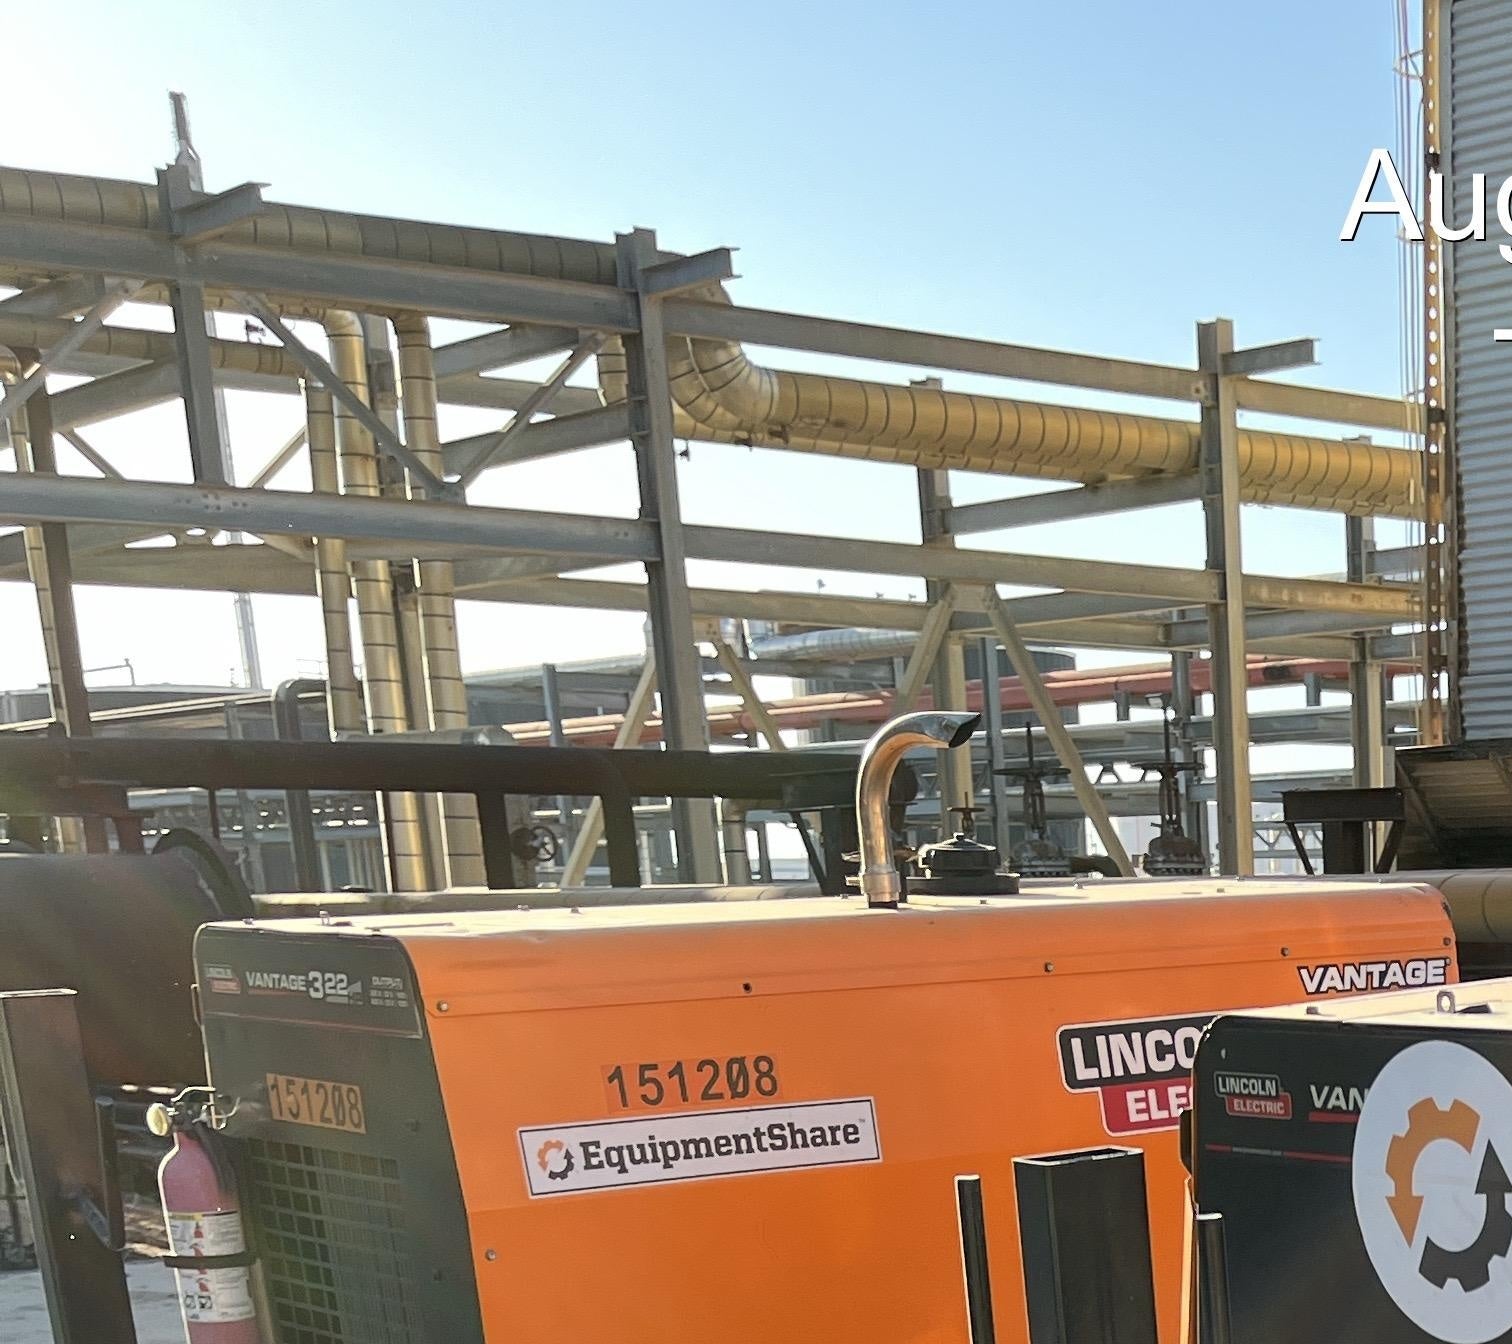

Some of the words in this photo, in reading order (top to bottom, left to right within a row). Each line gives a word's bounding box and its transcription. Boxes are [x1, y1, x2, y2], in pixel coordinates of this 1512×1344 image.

[245, 971, 307, 992] VANTAGE
[308, 970, 349, 999] 322
[1299, 958, 1447, 994] VANTAGE
[1070, 1026, 1204, 1081] LINCO
[270, 1076, 364, 1129] 151208
[607, 1055, 779, 1109] 151208
[1218, 1076, 1278, 1097] LINCOLN
[1233, 1098, 1286, 1115] ELECTRIC
[579, 1122, 861, 1175] EquipmentShare
